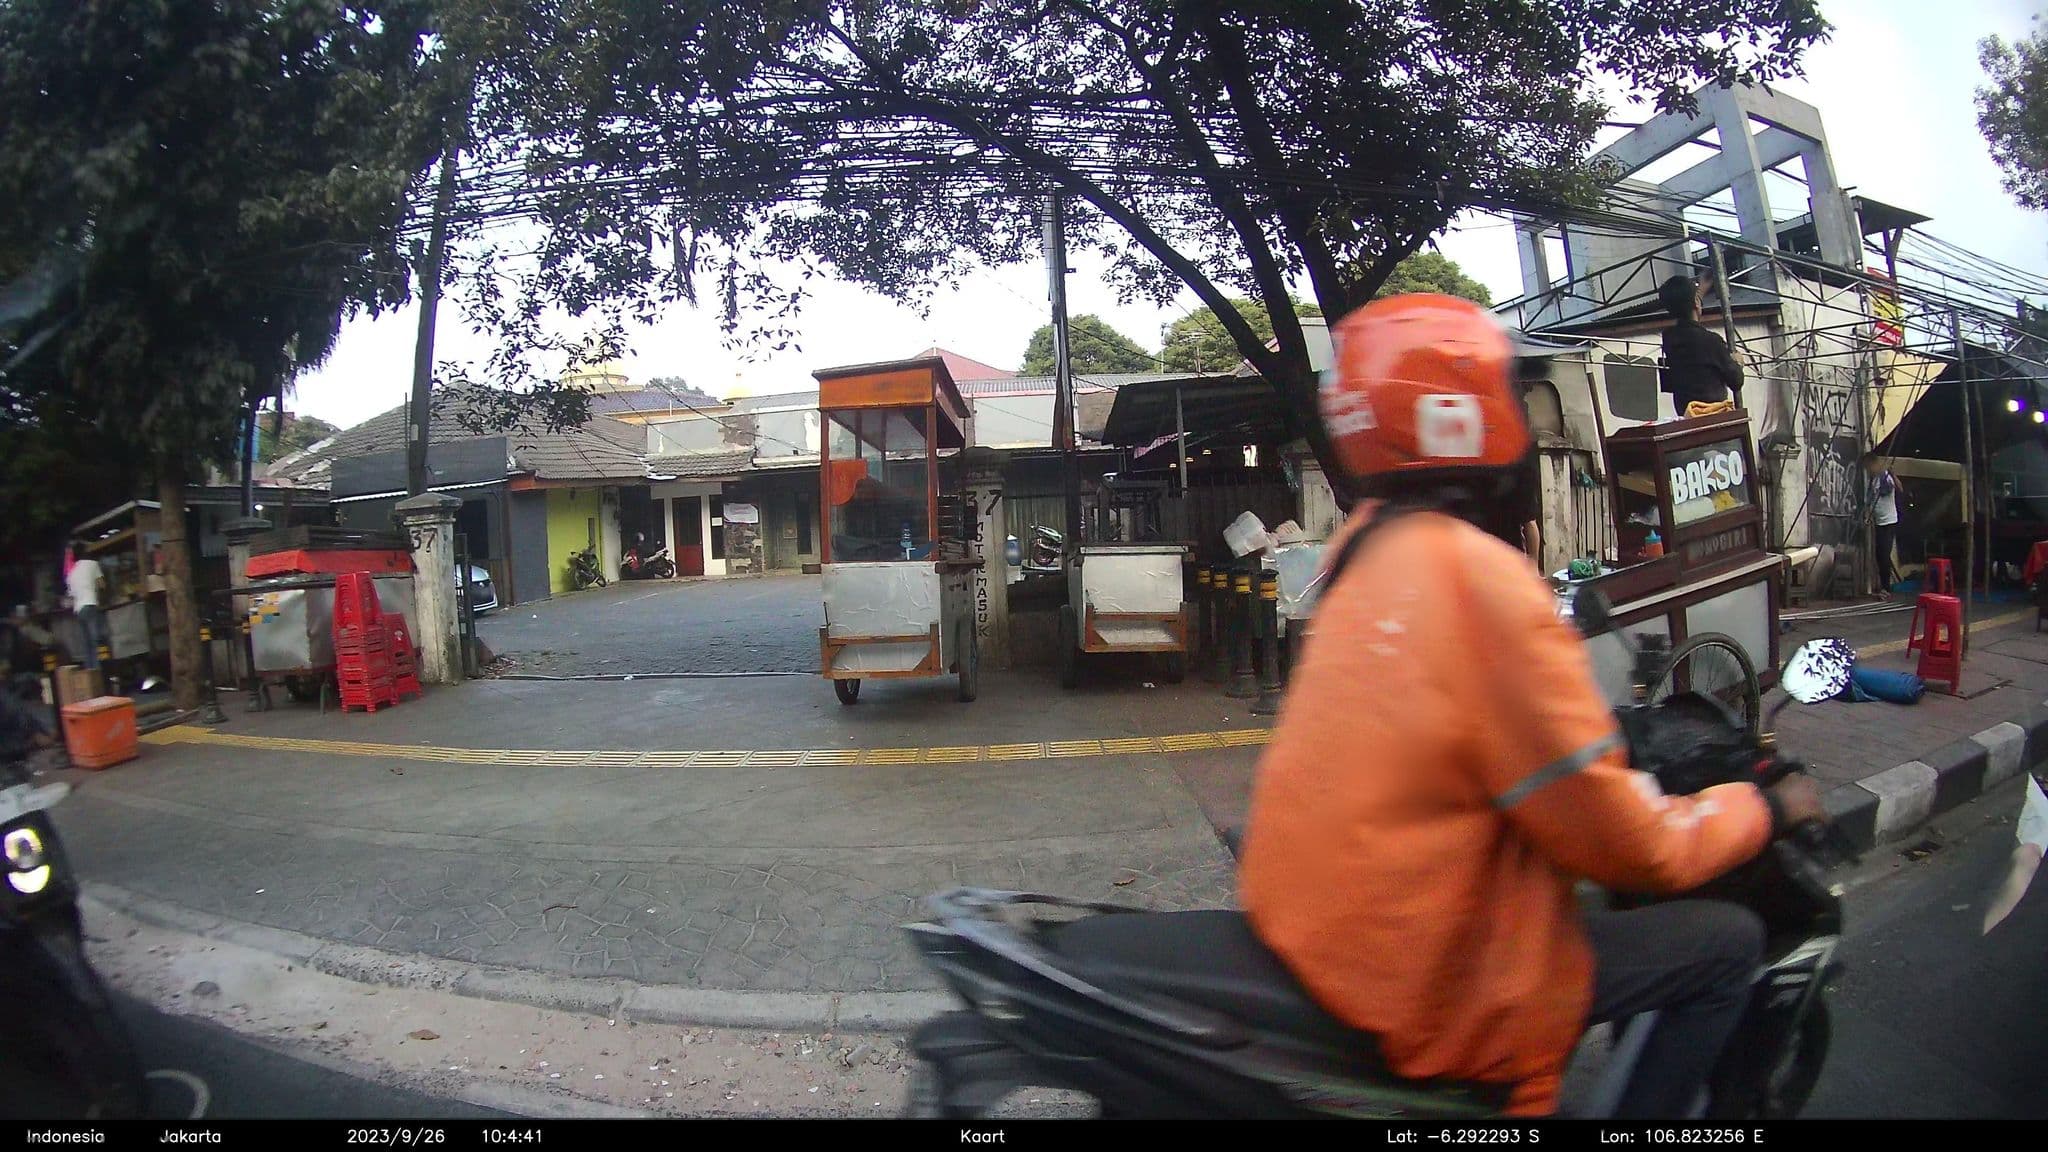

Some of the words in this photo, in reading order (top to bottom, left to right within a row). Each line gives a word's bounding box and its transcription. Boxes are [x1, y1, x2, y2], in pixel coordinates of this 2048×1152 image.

[1670, 450, 1744, 505] BAKSO
[410, 527, 438, 553] 37
[976, 577, 989, 637] MASUK
